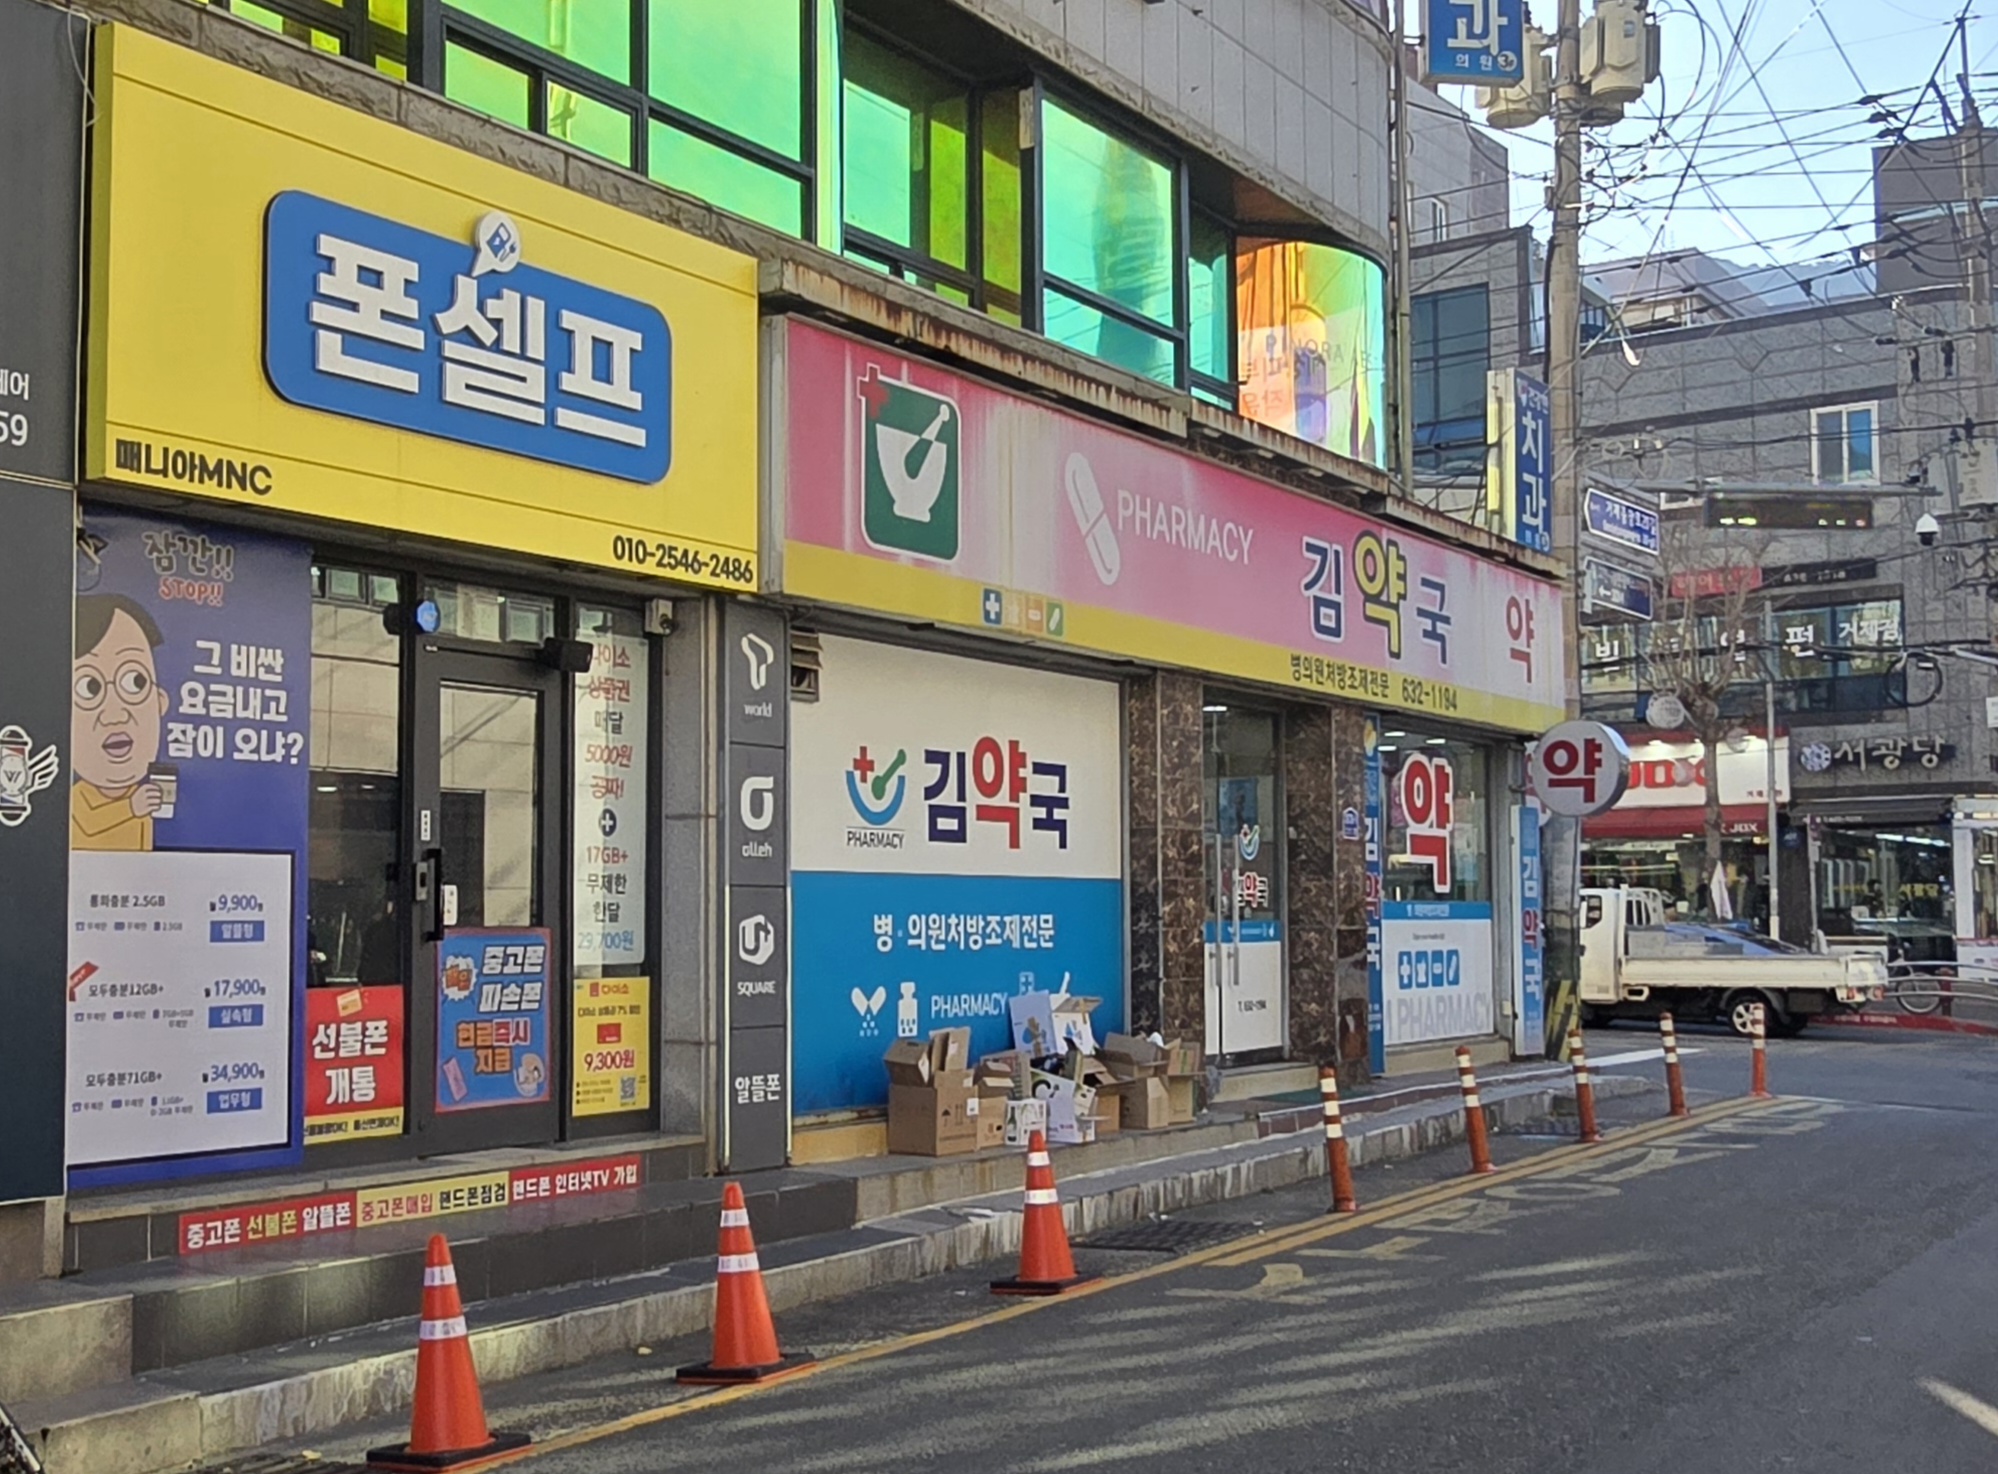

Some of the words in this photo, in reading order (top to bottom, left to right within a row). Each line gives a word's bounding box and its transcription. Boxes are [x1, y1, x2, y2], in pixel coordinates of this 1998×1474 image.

[309, 232, 648, 448] 폰셀프
[115, 437, 274, 497] 매니아MNC
[1522, 411, 1547, 534] 치과
[1117, 490, 1254, 565] PHARMACY
[142, 530, 234, 582] 잠깐!!
[612, 533, 754, 586] 010-2546-2486
[159, 577, 223, 607] STOP!!
[1301, 530, 1452, 665] 김약국
[1506, 595, 1535, 684] 약
[193, 640, 223, 675] 그
[230, 645, 285, 682] 비싼
[1290, 653, 1390, 699] 병의원처방조제전문
[179, 681, 289, 722] 요금내고
[743, 703, 773, 718] world
[167, 722, 225, 759] 잠이
[232, 729, 305, 765] 오냐?
[585, 744, 633, 769] 5000원
[1834, 735, 1946, 772] 서광당
[590, 774, 625, 801] 공짜!
[1543, 738, 1602, 804] 약
[924, 736, 1070, 849] 김약국
[846, 831, 905, 849] PHARMACY
[1402, 755, 1452, 892] 약
[586, 845, 629, 865] 17GB+
[742, 842, 773, 858] olleh
[586, 874, 628, 895] 무제한
[592, 900, 621, 923] 한달
[482, 946, 546, 974] 중고폰
[479, 982, 542, 1012] 파손폰
[737, 980, 776, 997] SQUARE
[930, 992, 1008, 1019] PHARMACY
[312, 1020, 388, 1059] 선불폰
[457, 1017, 531, 1047] 현금즉시
[475, 1048, 513, 1074] 지급
[584, 1050, 635, 1072] 9,300원
[325, 1066, 376, 1105] 개통
[734, 1074, 781, 1104] 알뜰폰
[186, 1220, 241, 1250] 중고폰
[247, 1211, 298, 1240] 선불폰
[302, 1200, 351, 1232] 알뜰폰
[361, 1193, 433, 1222] 중고폰매입
[438, 1182, 507, 1211] 핸드폰점검
[513, 1176, 551, 1200] 핸드폰
[555, 1169, 611, 1194] 인터넷TV
[613, 1164, 639, 1187] 가입
